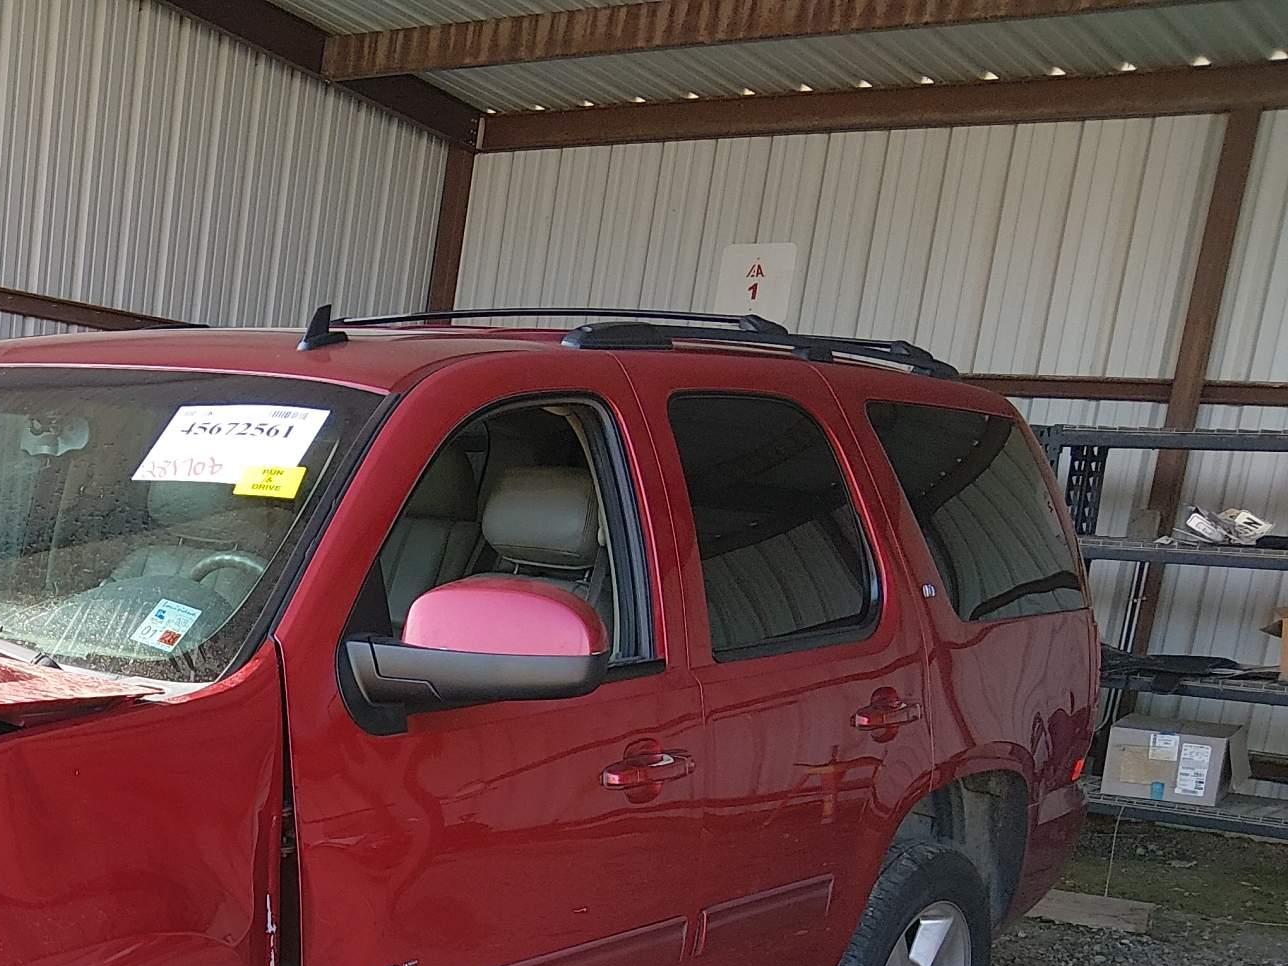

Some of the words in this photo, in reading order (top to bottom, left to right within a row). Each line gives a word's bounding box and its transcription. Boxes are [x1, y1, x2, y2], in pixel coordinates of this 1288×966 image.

[747, 283, 759, 300] 1
[180, 421, 295, 439] 45672561
[251, 483, 282, 492] DRIVE
